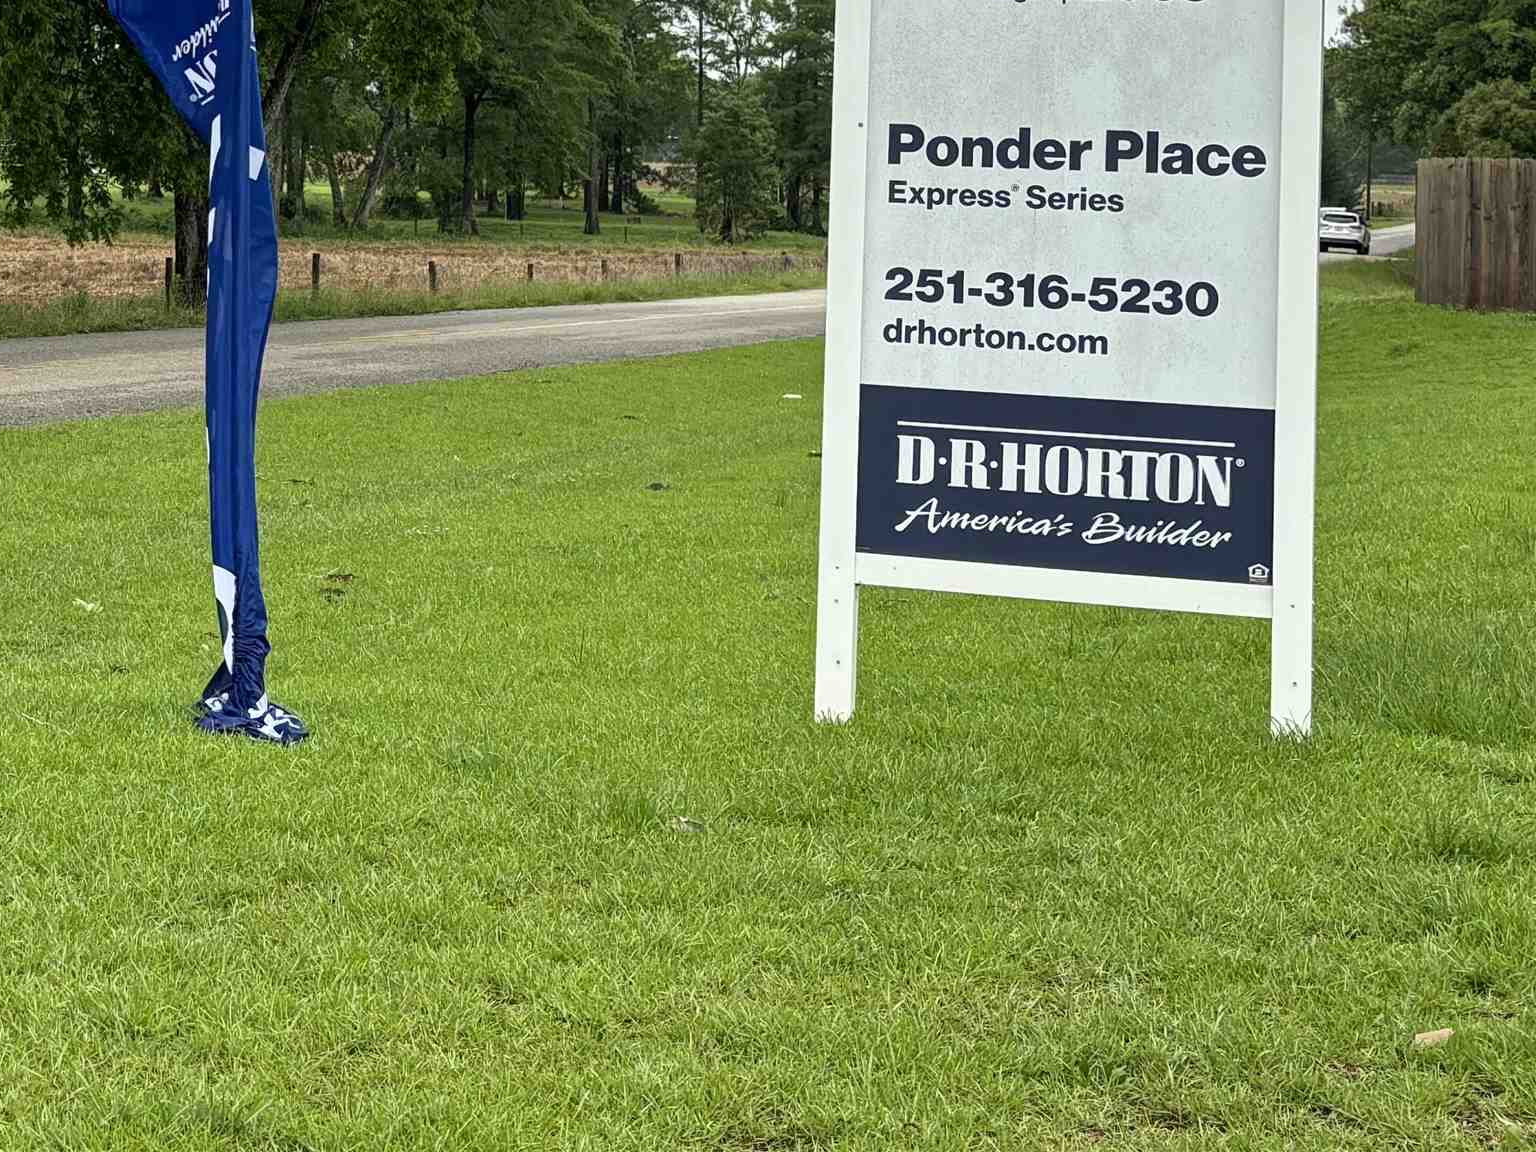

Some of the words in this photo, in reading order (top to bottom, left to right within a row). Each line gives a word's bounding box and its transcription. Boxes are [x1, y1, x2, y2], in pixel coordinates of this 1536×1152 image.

[887, 123, 1093, 172] Ponder
[1105, 129, 1267, 178] Place
[1025, 184, 1125, 213] Series
[884, 266, 1219, 317] 251-316-5230
[883, 317, 1109, 355] drhorton.com
[894, 496, 1074, 534] America's
[1080, 511, 1233, 549] Builder
